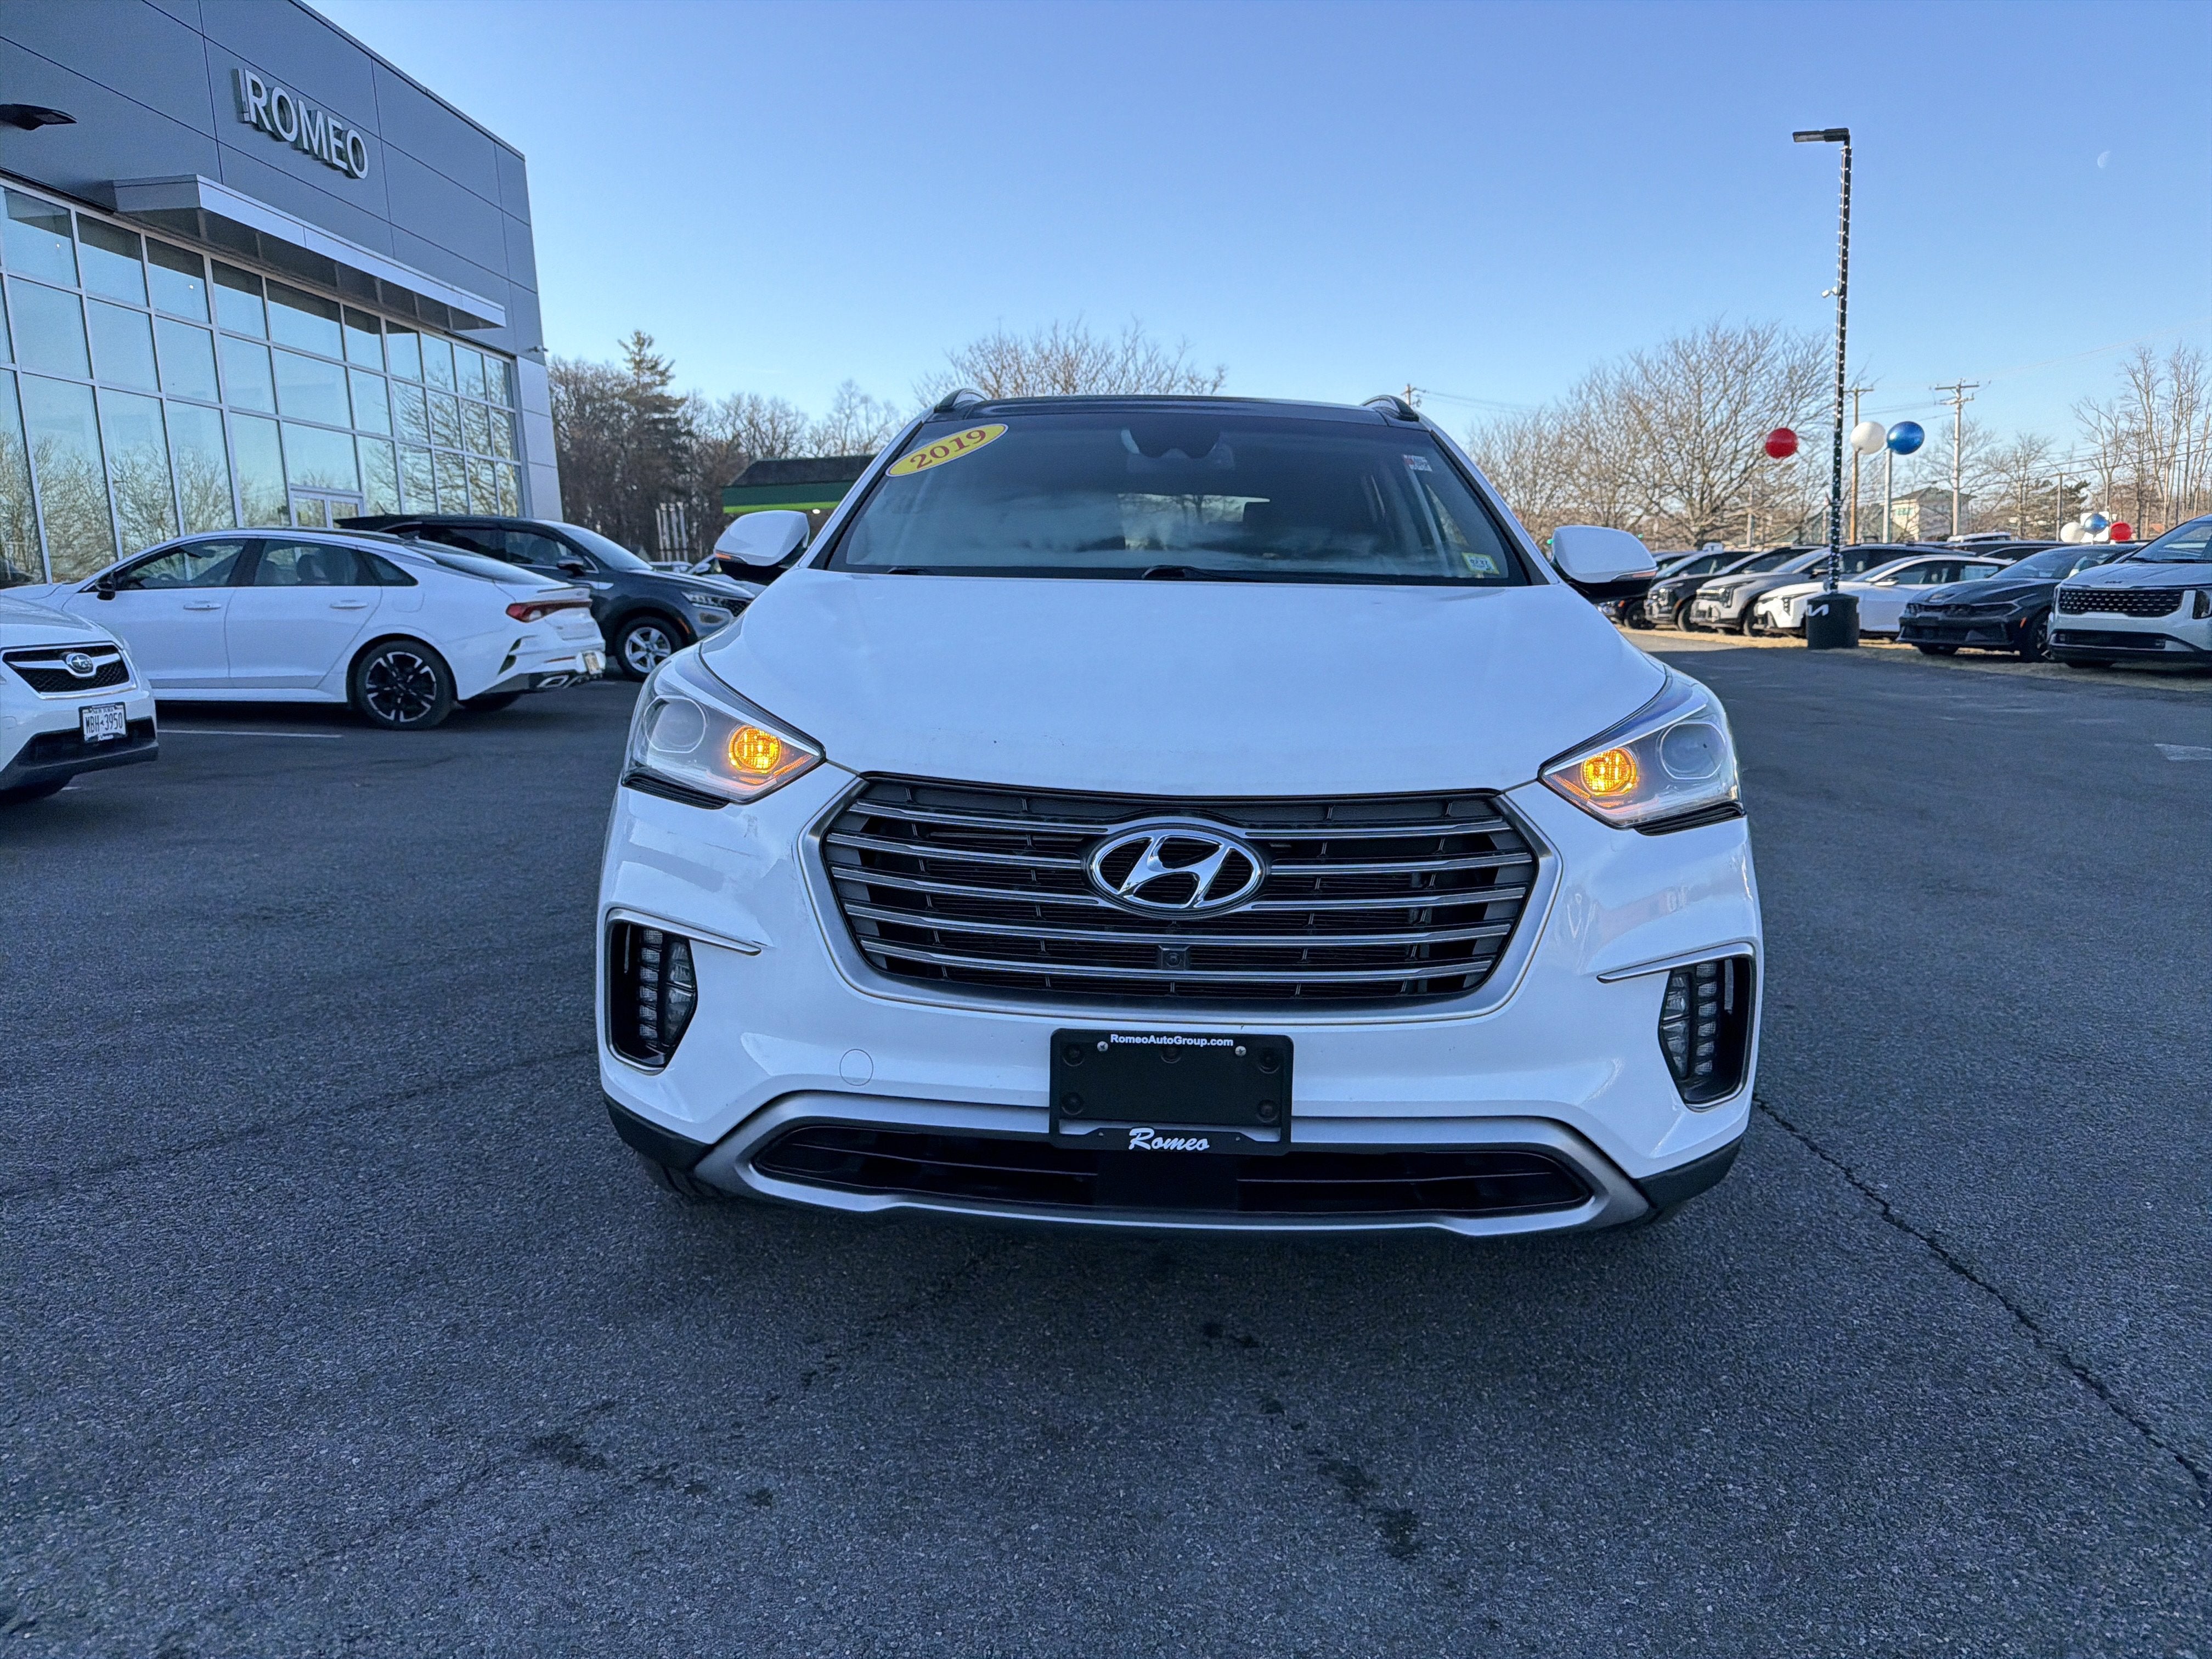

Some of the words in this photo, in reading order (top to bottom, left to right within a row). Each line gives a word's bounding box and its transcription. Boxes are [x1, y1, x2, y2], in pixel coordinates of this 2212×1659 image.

[240, 68, 369, 179] ROMEO
[910, 430, 986, 469] 2019
[104, 712, 123, 731] 3950
[1110, 1034, 1234, 1047] RomeoAutoGroup.com
[1128, 1127, 1210, 1151] Romeo
